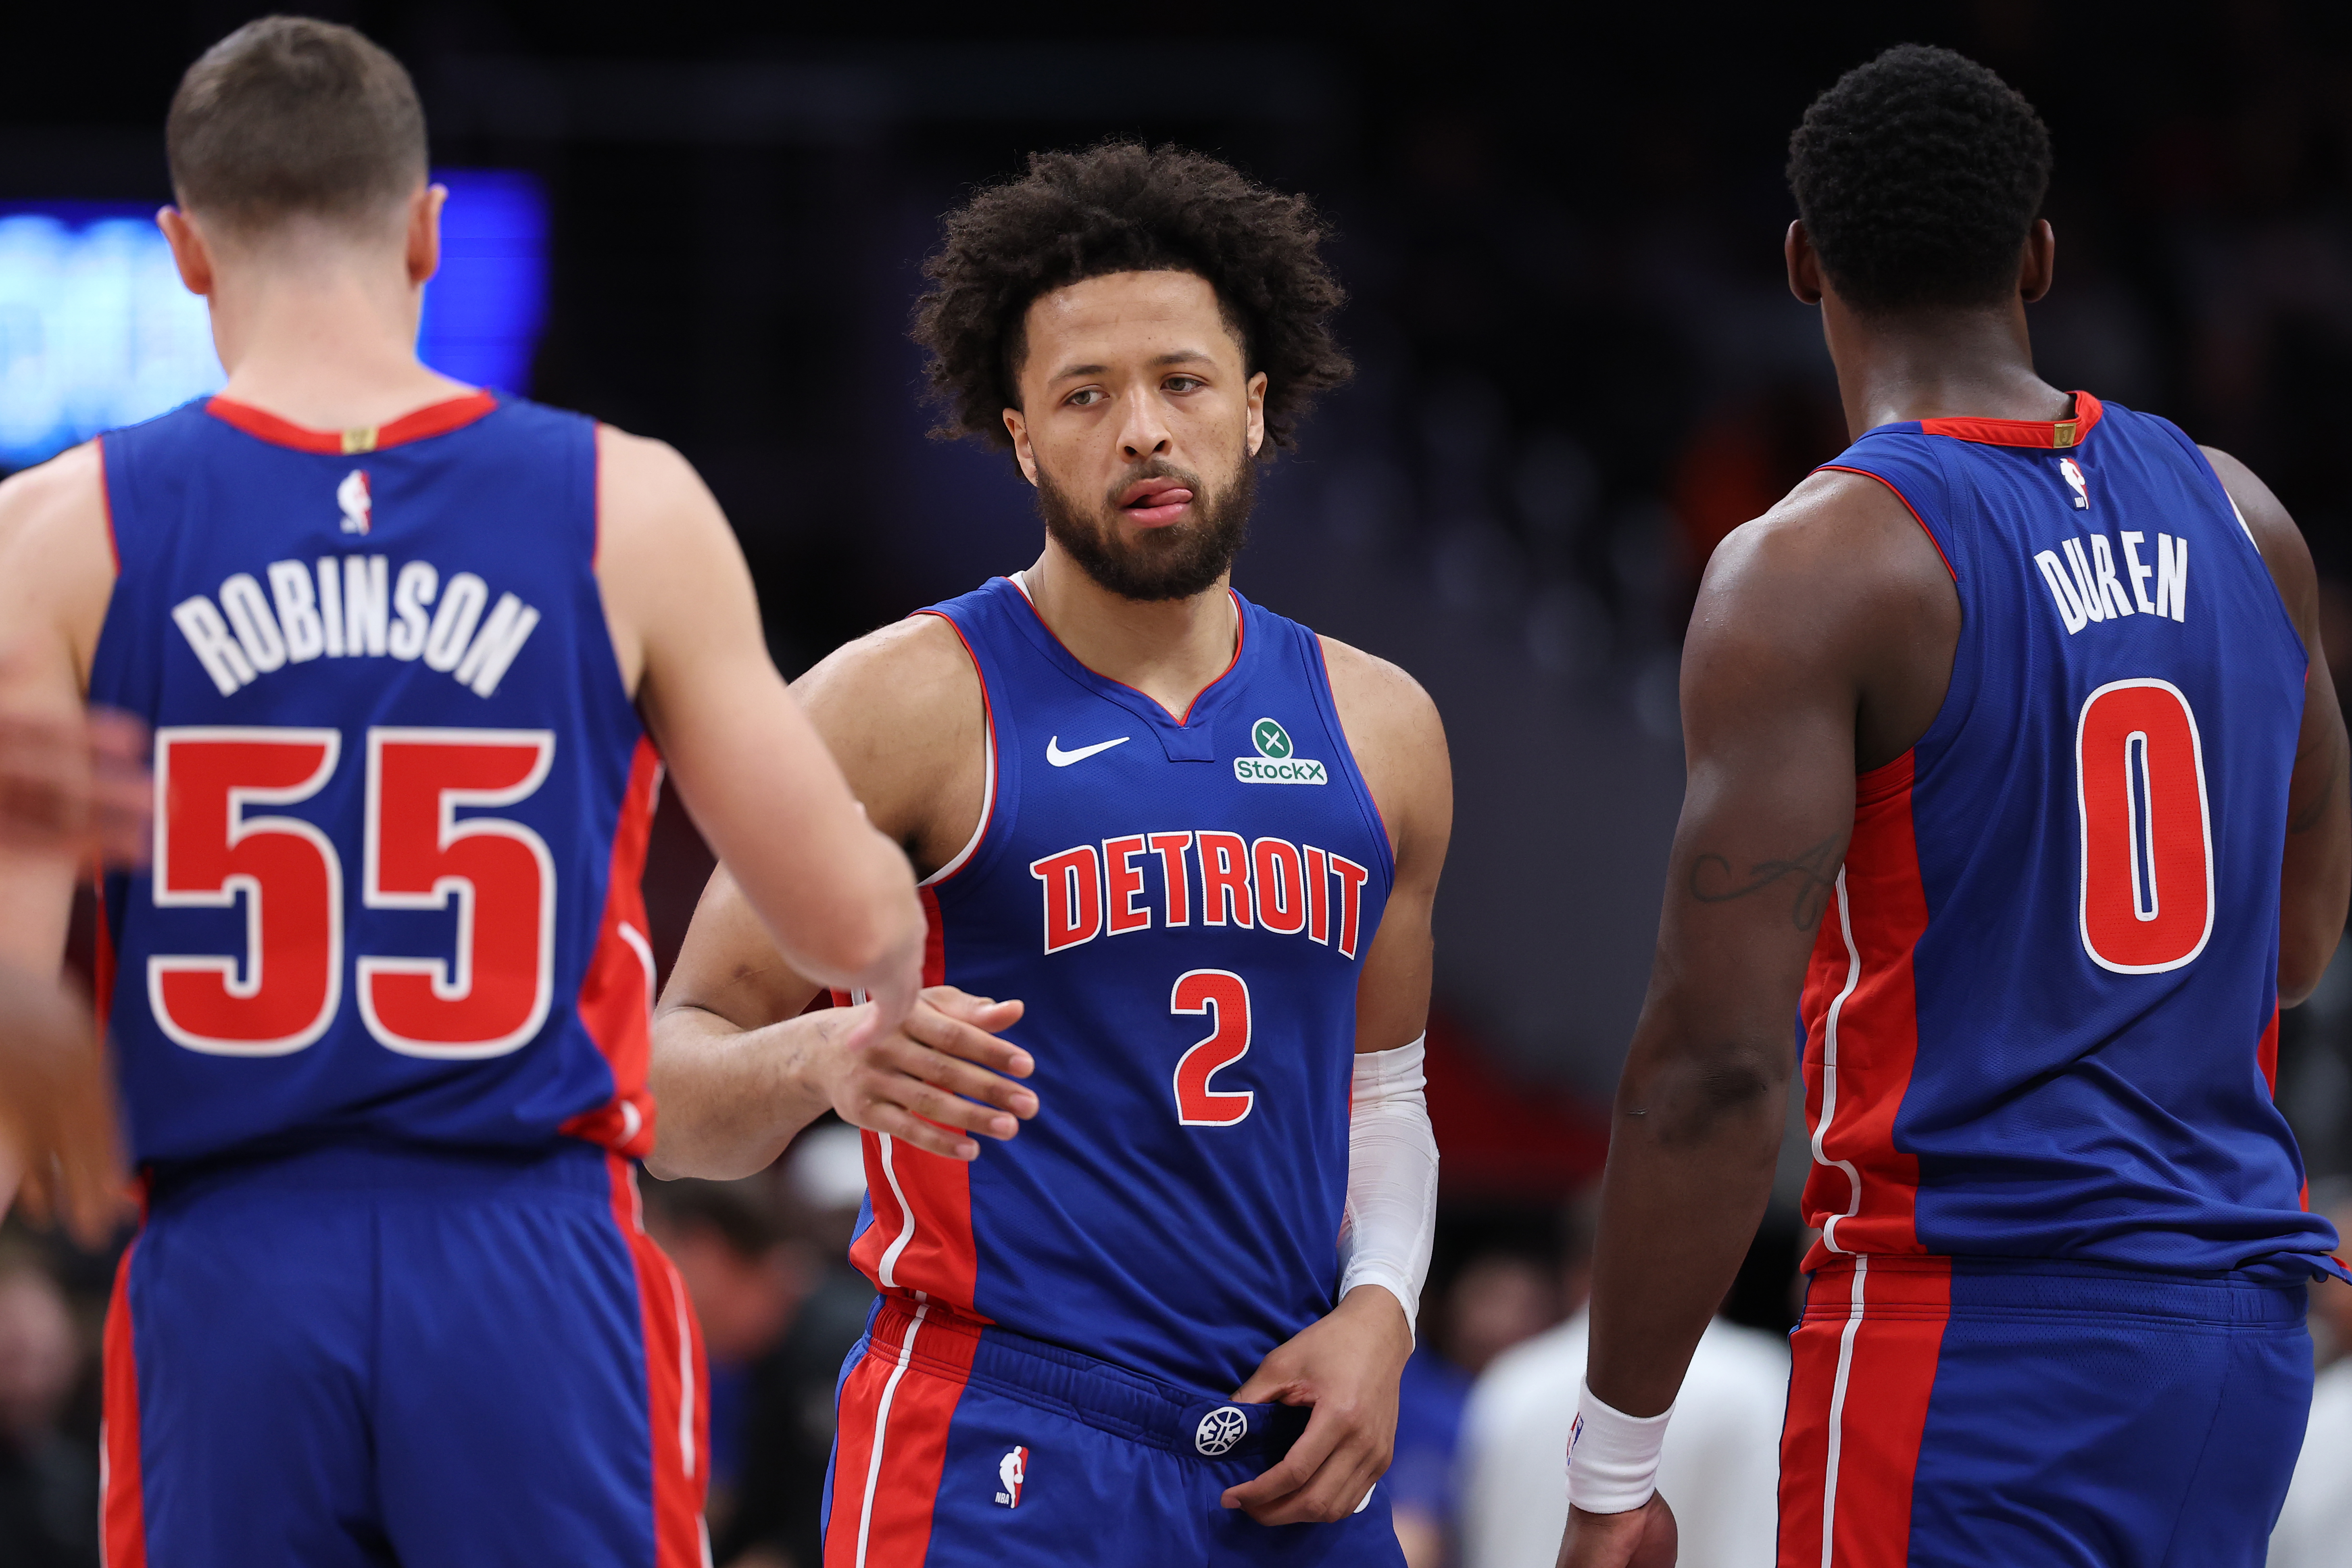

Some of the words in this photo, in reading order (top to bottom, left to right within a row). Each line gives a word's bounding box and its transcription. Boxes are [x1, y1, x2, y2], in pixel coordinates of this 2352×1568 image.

[171, 554, 542, 698] ROBINSON
[2034, 530, 2187, 635] DUREN
[1238, 760, 1324, 781] StockX
[2076, 677, 2215, 975] 0
[147, 726, 557, 1059] 55
[1029, 830, 1367, 960] DETROIT
[1171, 969, 1253, 1126] 2
[995, 1492, 1009, 1504] NBA
